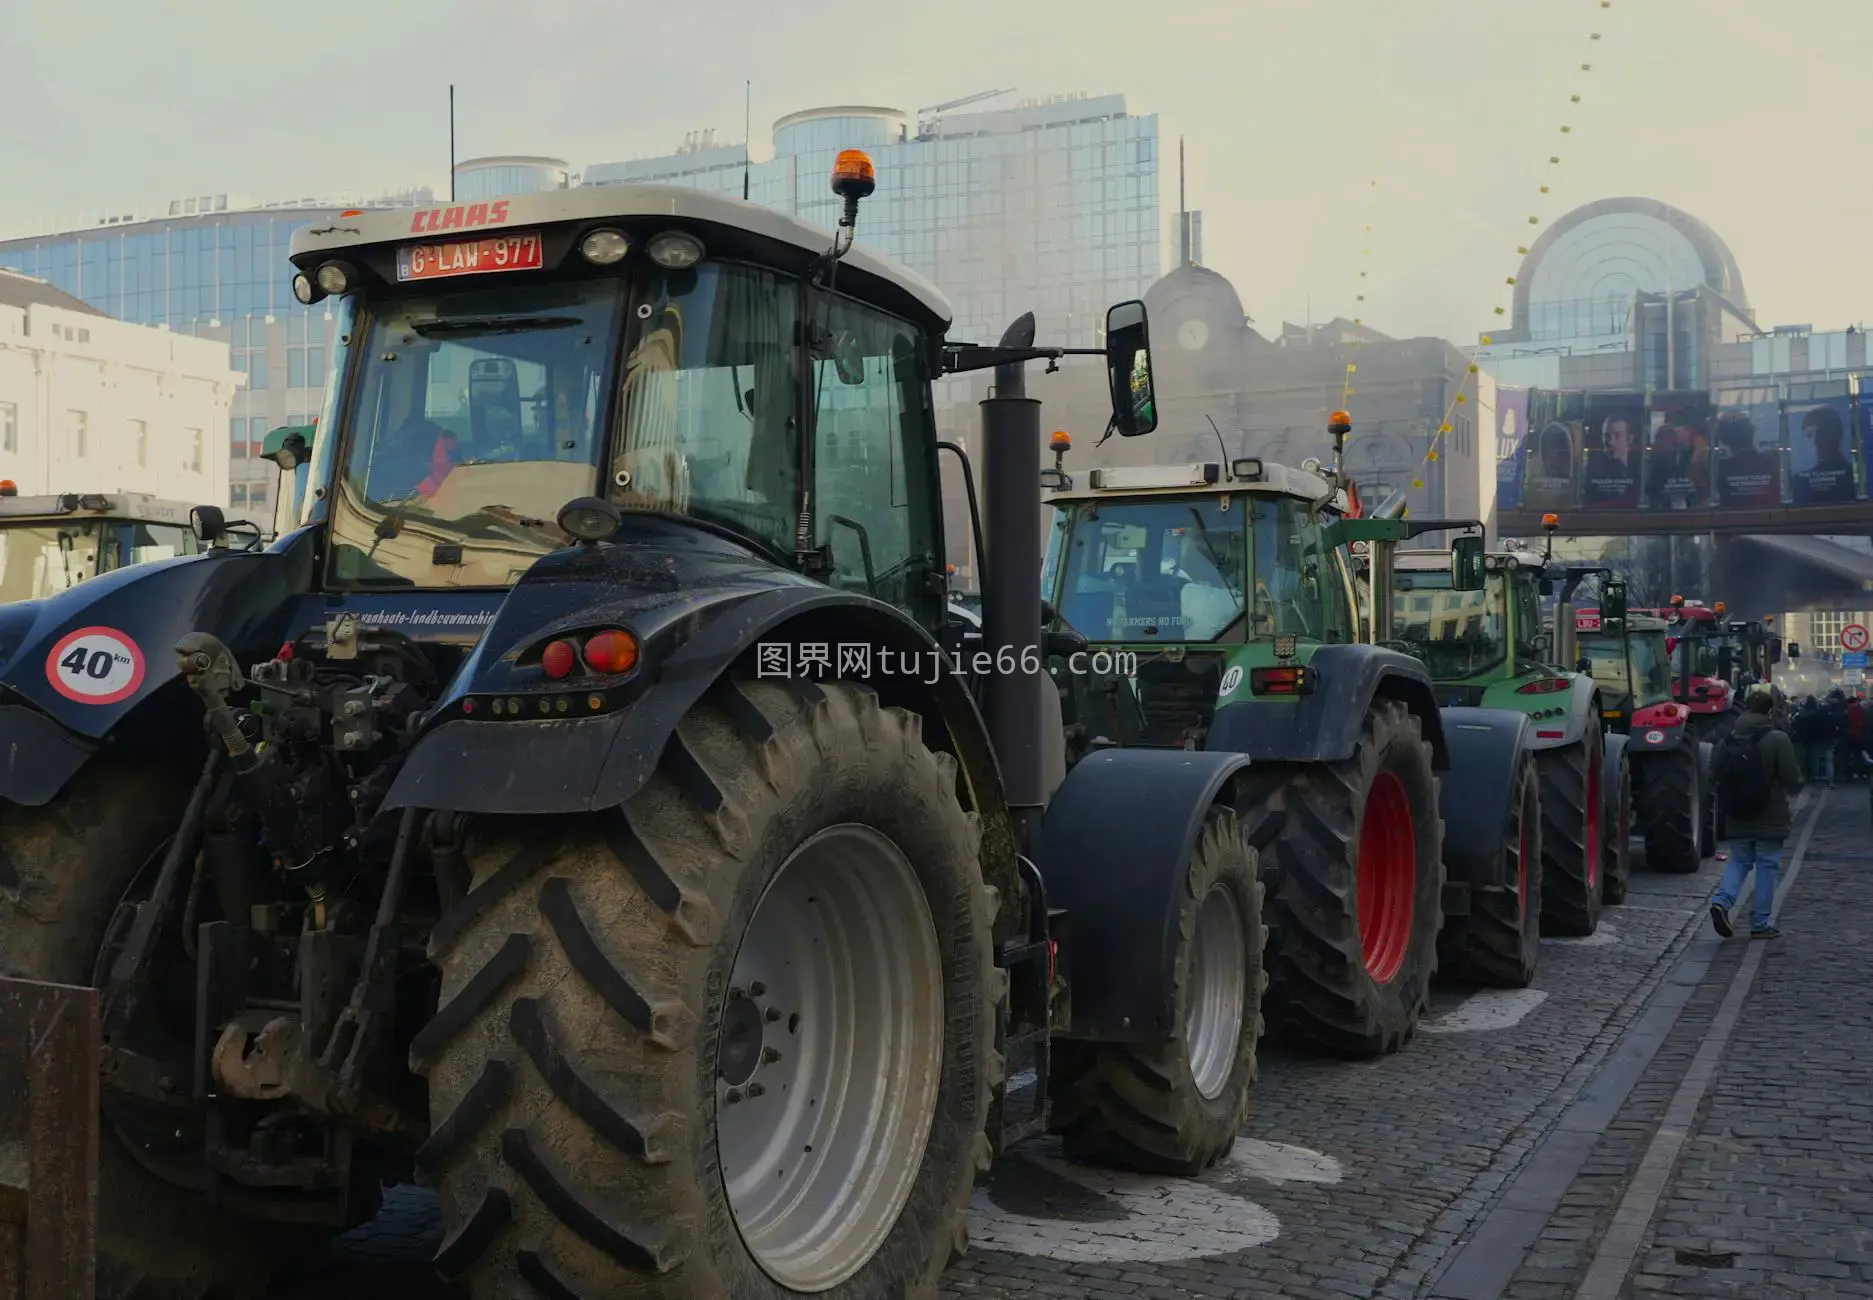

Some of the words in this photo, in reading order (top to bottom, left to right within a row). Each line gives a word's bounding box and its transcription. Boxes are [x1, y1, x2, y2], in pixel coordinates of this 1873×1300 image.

[410, 201, 511, 233] CLAAS
[1121, 617, 1156, 626] FARMERS
[1158, 616, 1169, 626] NO
[61, 647, 113, 679] 40
[1222, 669, 1239, 691] 40
